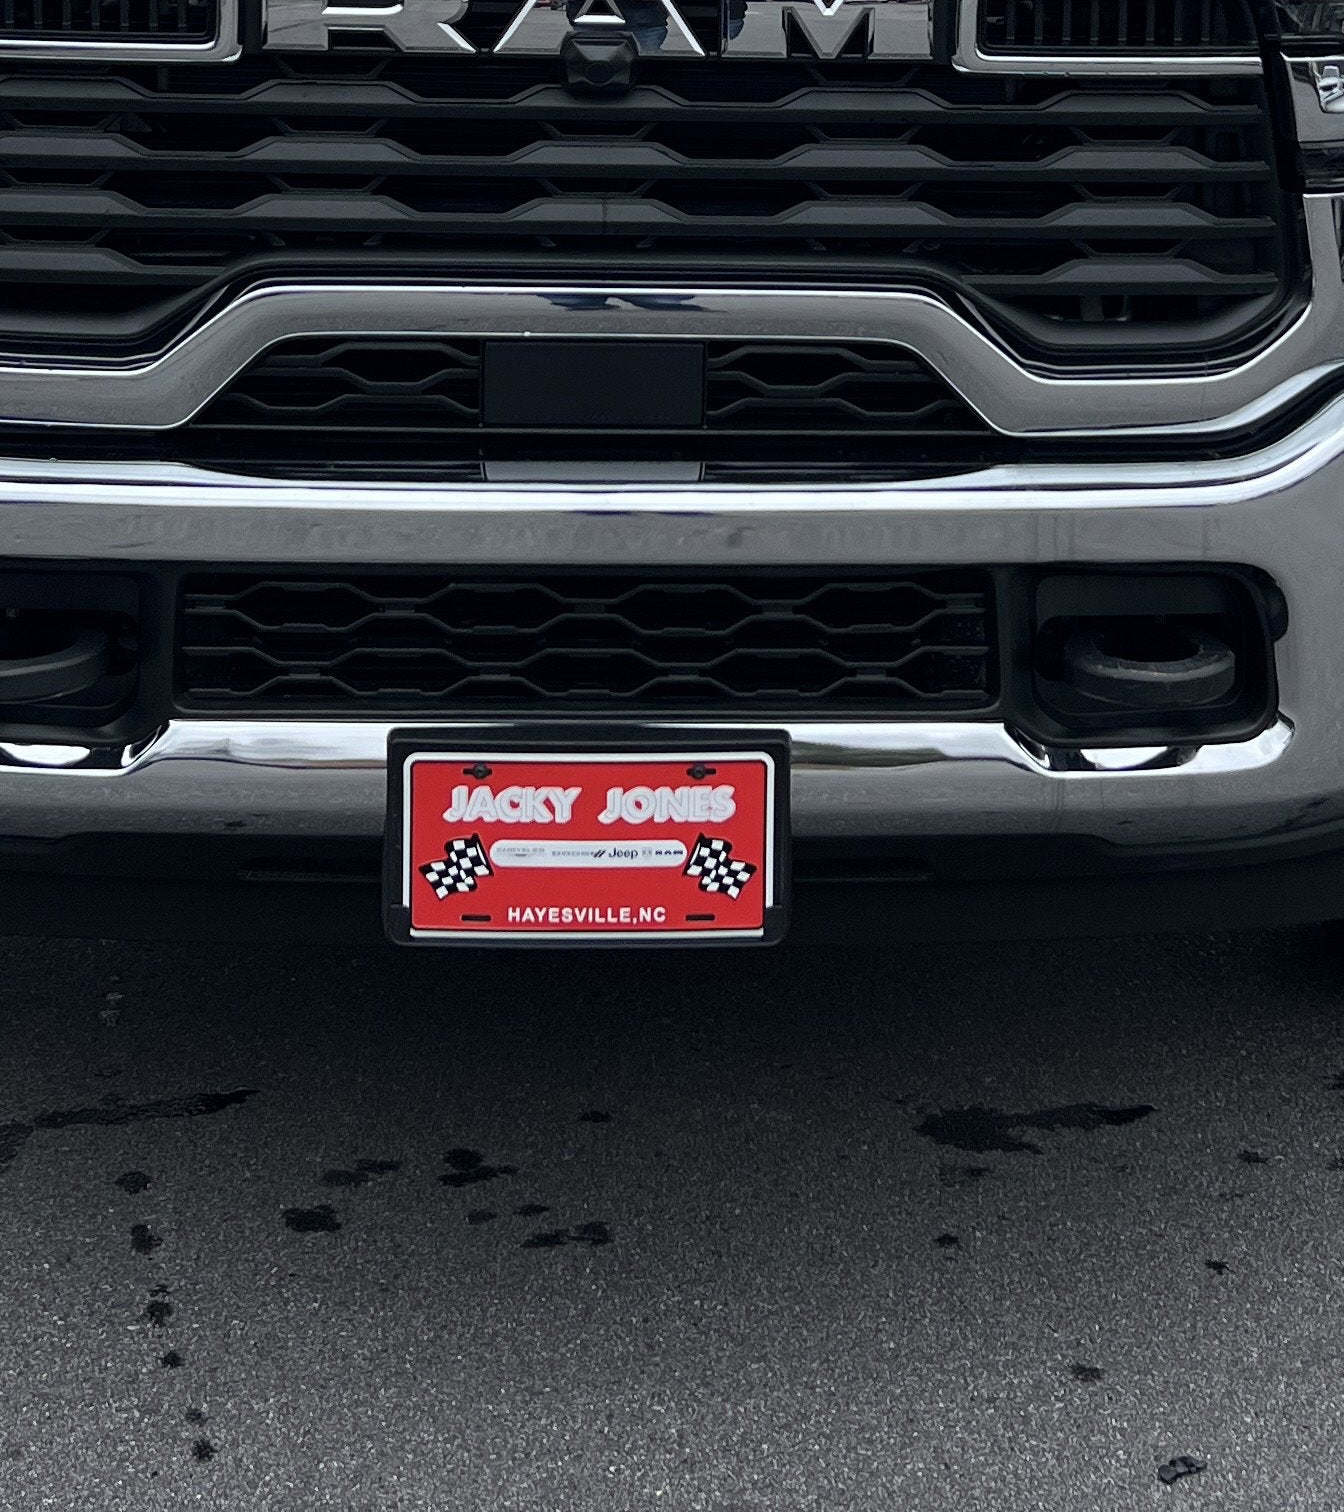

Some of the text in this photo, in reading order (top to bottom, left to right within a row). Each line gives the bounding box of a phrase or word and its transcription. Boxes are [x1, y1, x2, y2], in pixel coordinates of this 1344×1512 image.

[442, 785, 737, 824] JACKY JONES
[608, 847, 639, 859] Jeep
[507, 906, 666, 925] HAYESVILLE,NC
